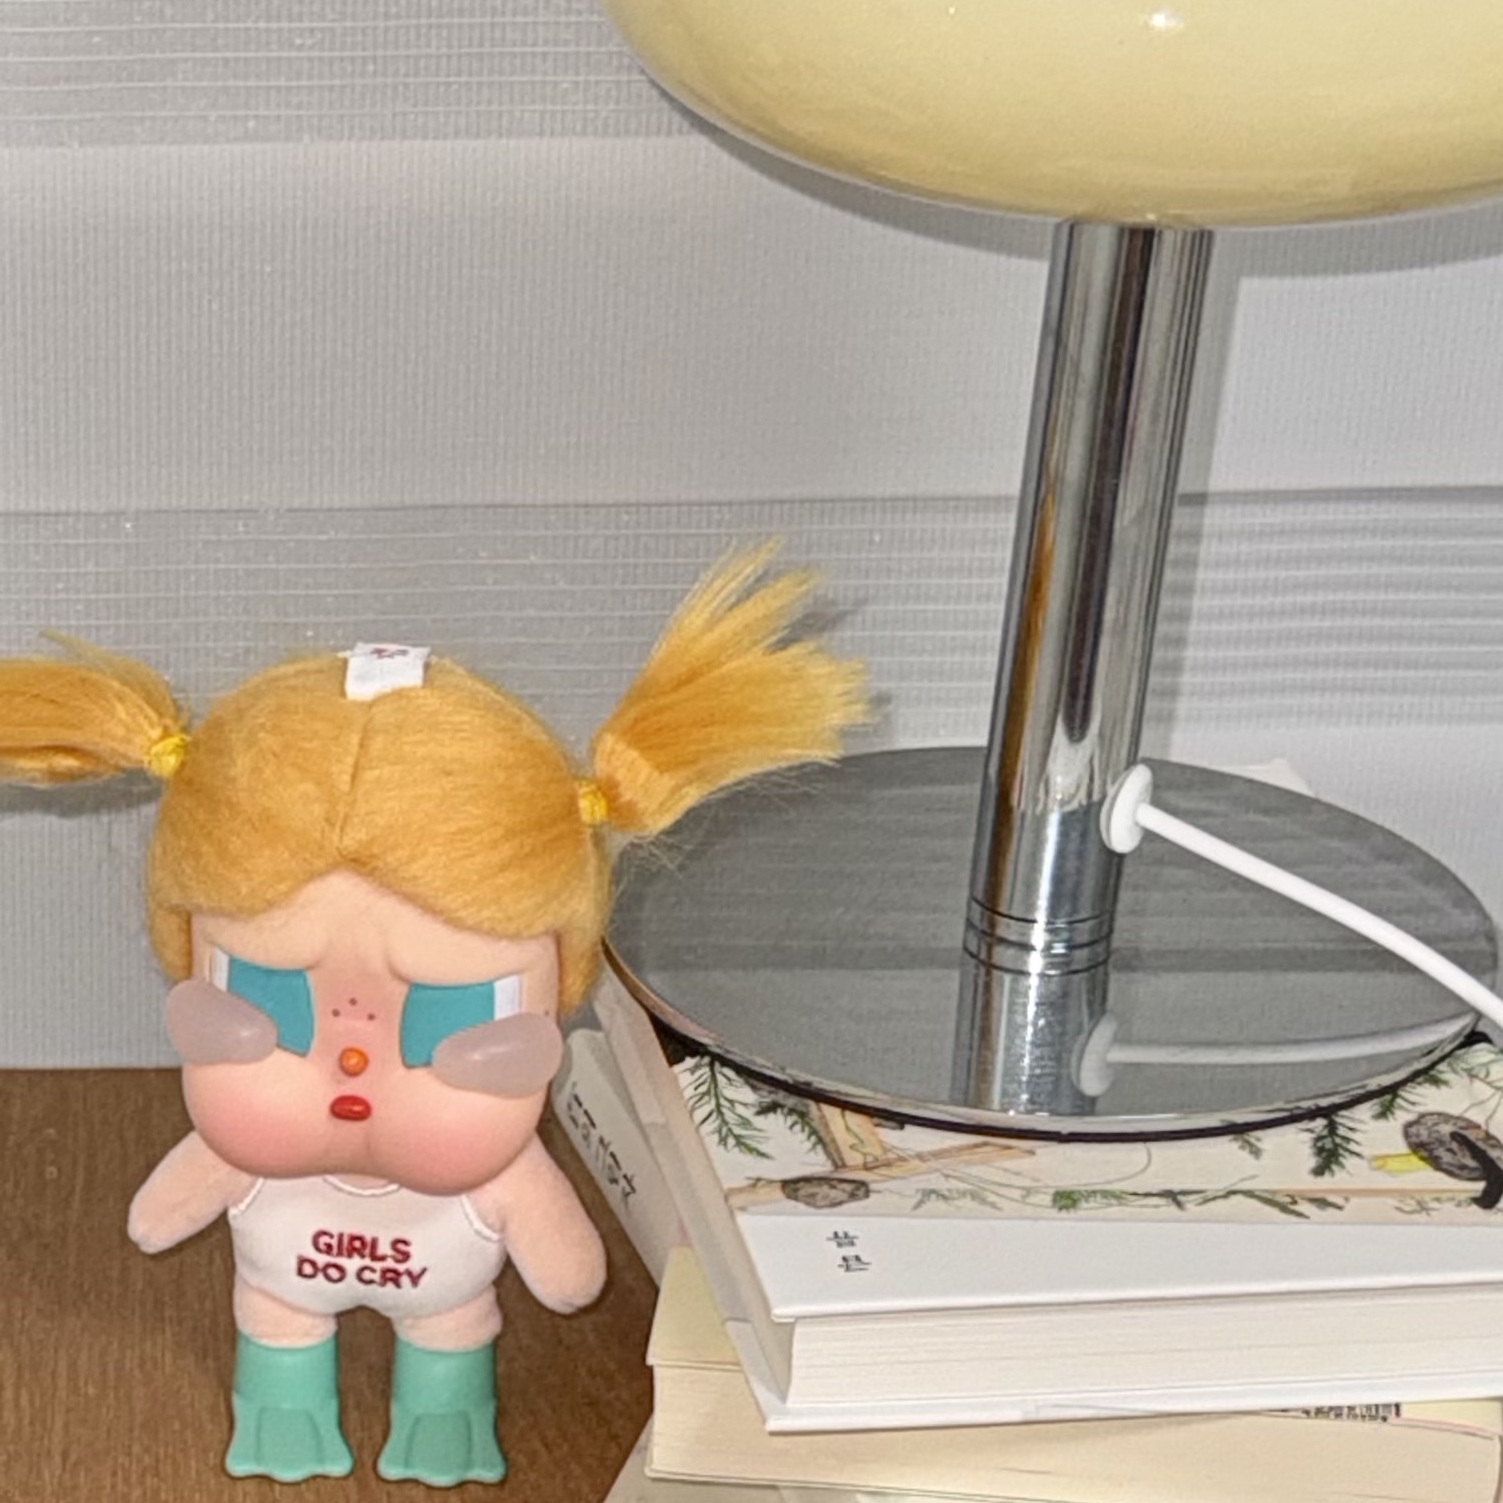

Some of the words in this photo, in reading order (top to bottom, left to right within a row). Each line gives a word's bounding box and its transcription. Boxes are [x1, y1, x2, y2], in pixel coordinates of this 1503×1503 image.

[311, 1229, 412, 1263] GIRLS
[296, 1255, 346, 1284] DO
[356, 1265, 429, 1289] CRY
